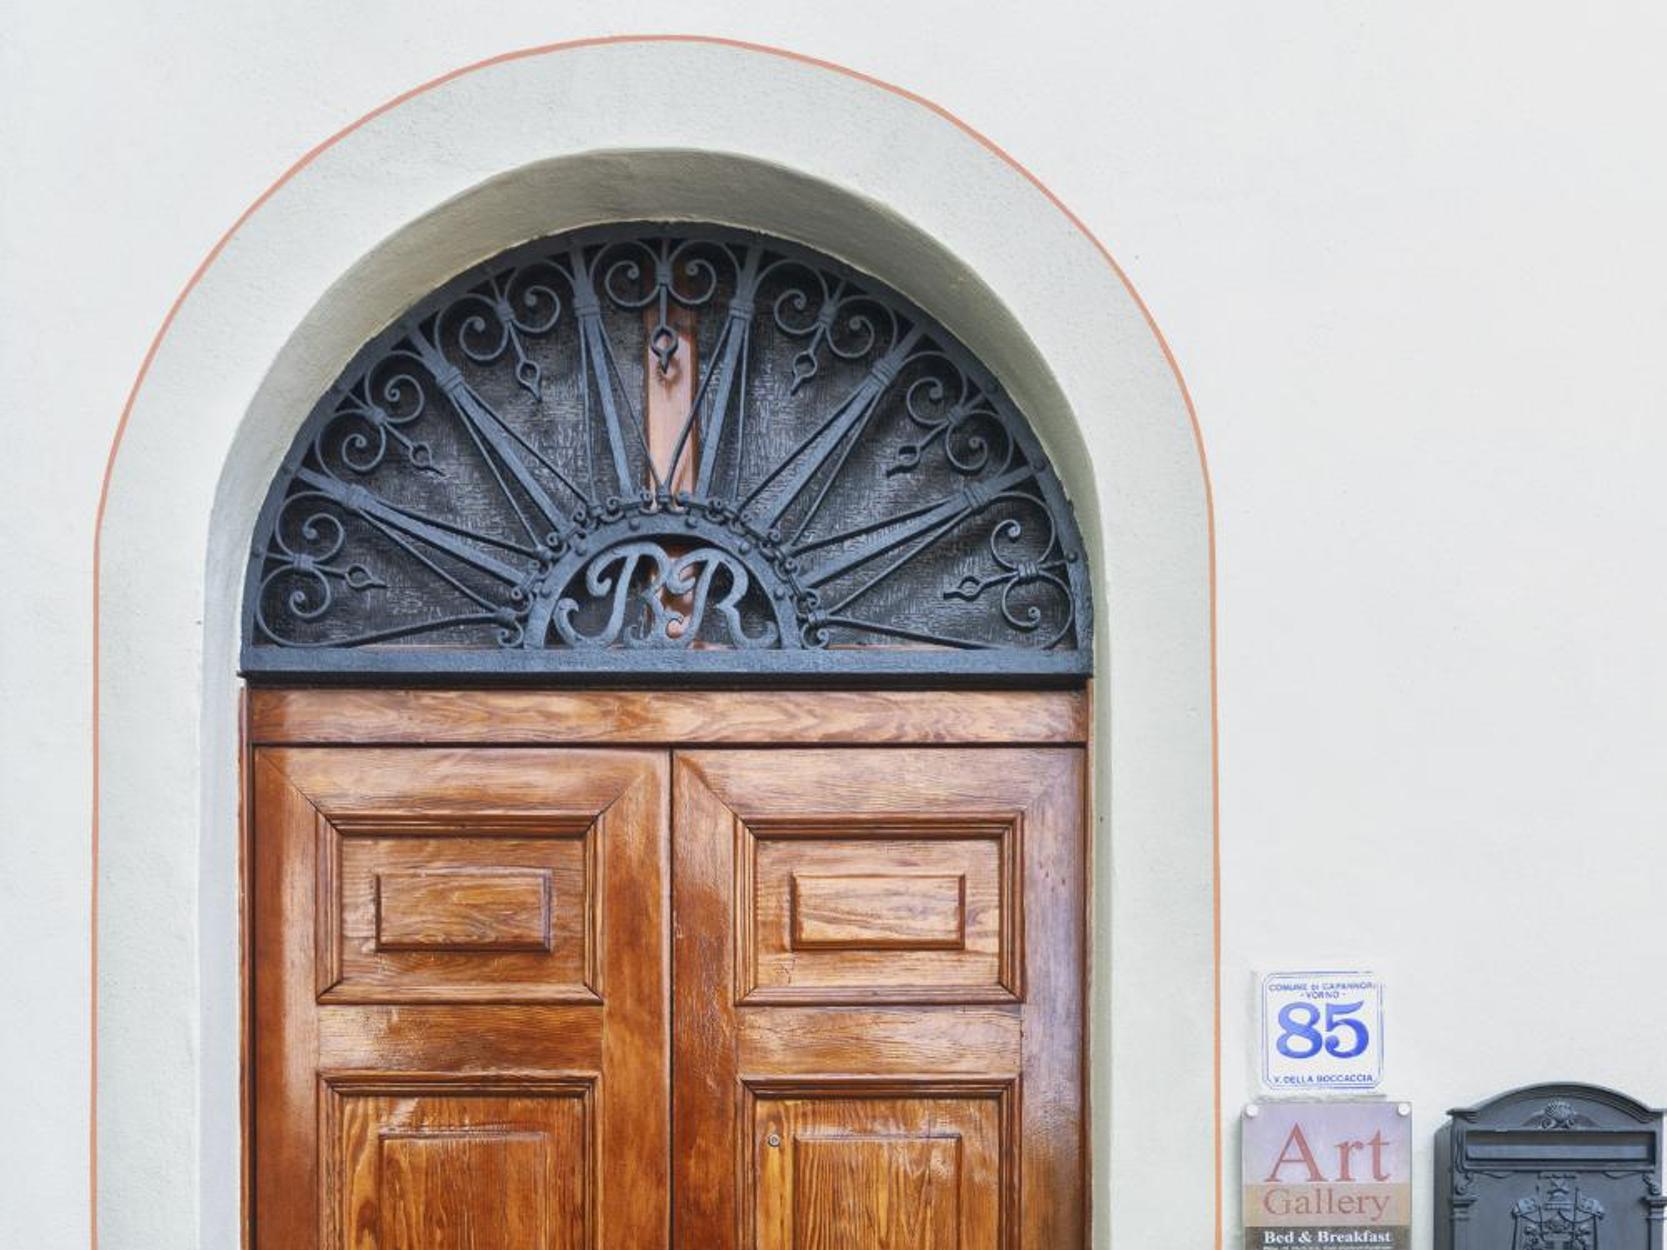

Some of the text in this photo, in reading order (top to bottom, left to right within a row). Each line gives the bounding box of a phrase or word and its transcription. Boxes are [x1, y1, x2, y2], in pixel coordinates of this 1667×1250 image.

[1276, 1000, 1369, 1059] 85
[1264, 1122, 1391, 1182] Art
[1263, 1188, 1391, 1222] Gallery
[1264, 1230, 1391, 1244] Bed & Breakfast
